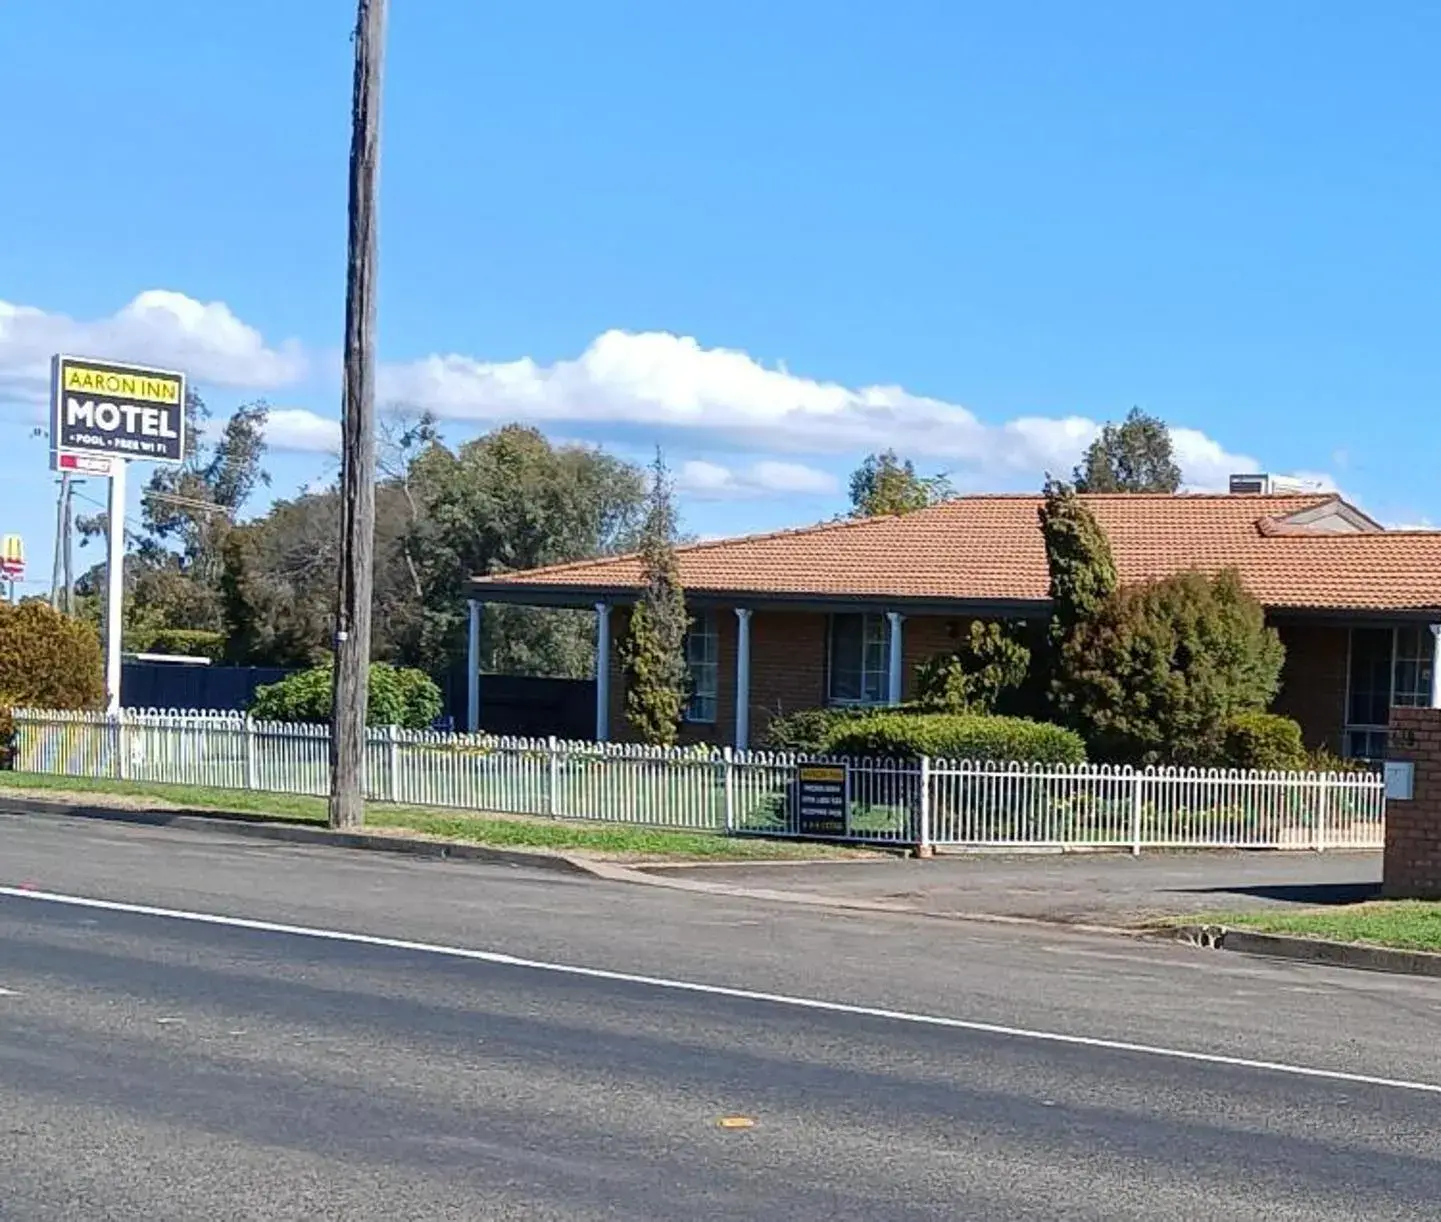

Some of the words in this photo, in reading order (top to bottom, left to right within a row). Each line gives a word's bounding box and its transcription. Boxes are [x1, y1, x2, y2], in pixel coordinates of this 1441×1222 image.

[70, 372, 135, 393] AARON
[141, 381, 175, 399] INN
[67, 398, 177, 438] MOTEL
[76, 434, 105, 446] POOL
[114, 438, 139, 450] FREE
